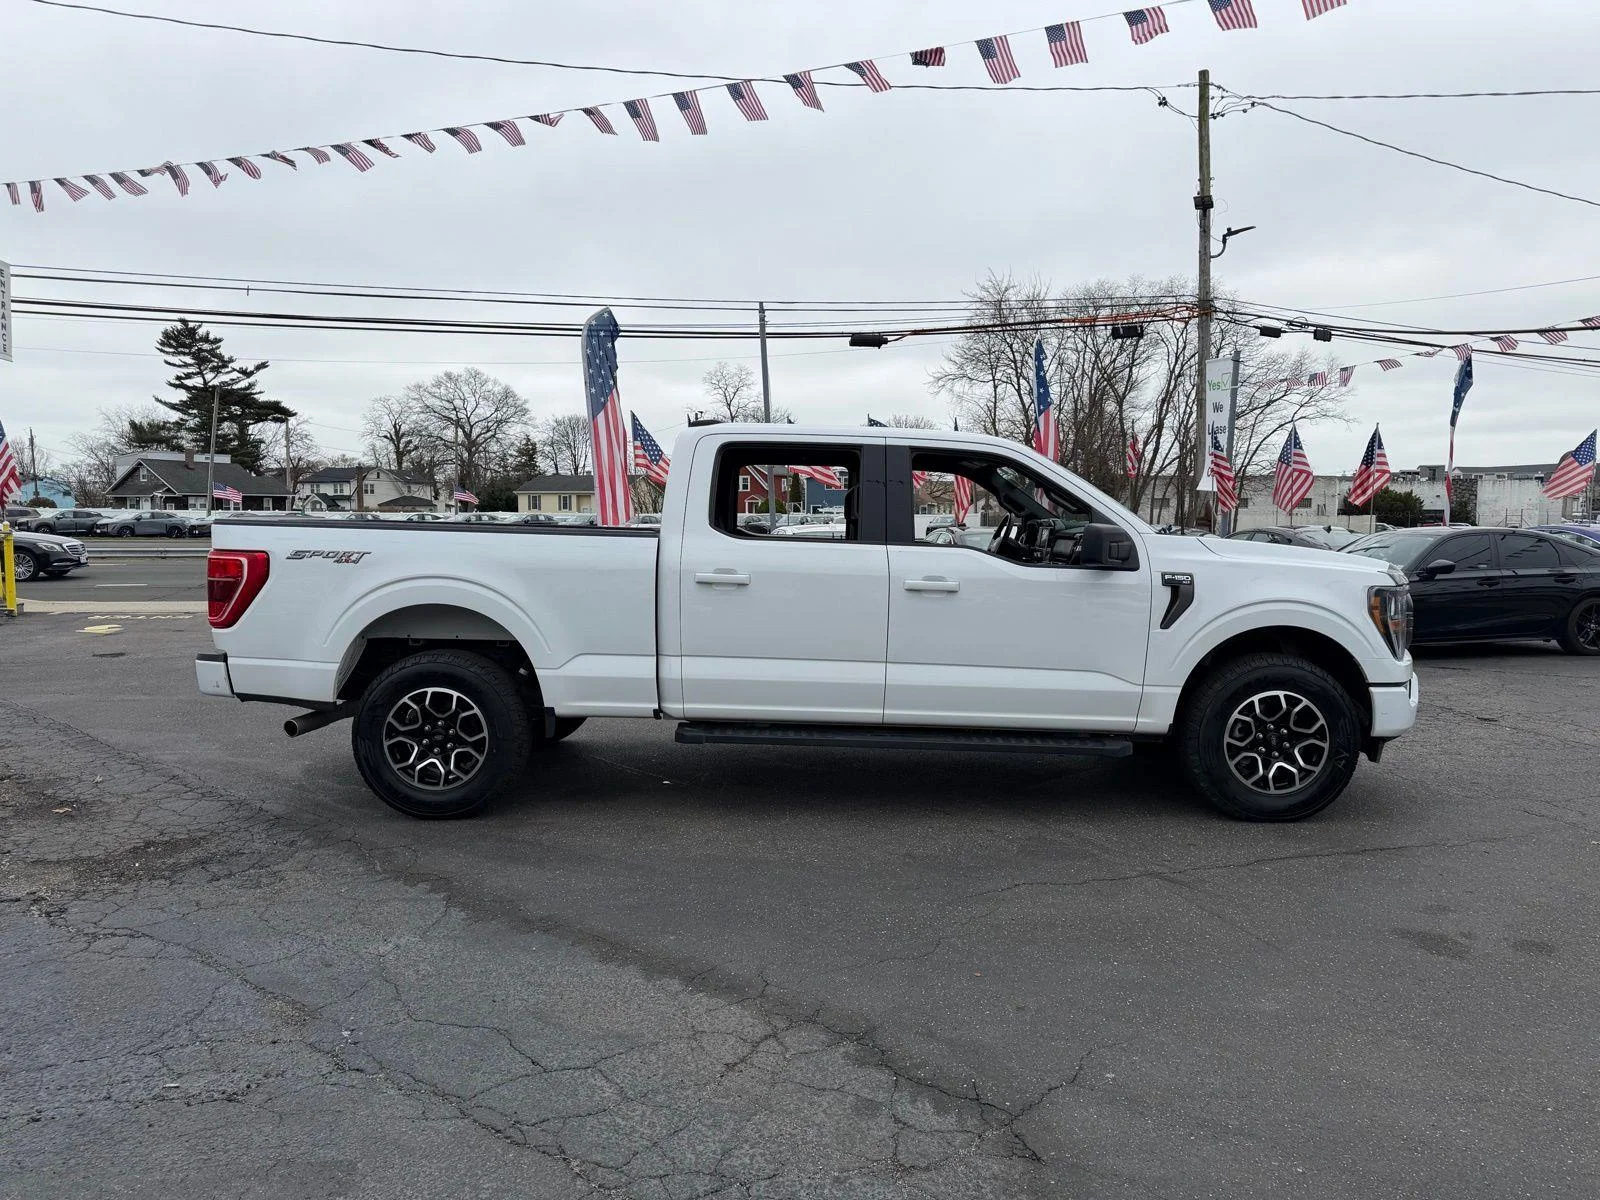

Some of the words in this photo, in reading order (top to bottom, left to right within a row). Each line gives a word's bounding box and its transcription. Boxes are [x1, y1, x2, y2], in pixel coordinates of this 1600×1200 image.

[1207, 380, 1221, 391] Yes
[1212, 401, 1224, 413] We
[1207, 423, 1227, 435] Lase
[286, 550, 372, 564] SPORT
